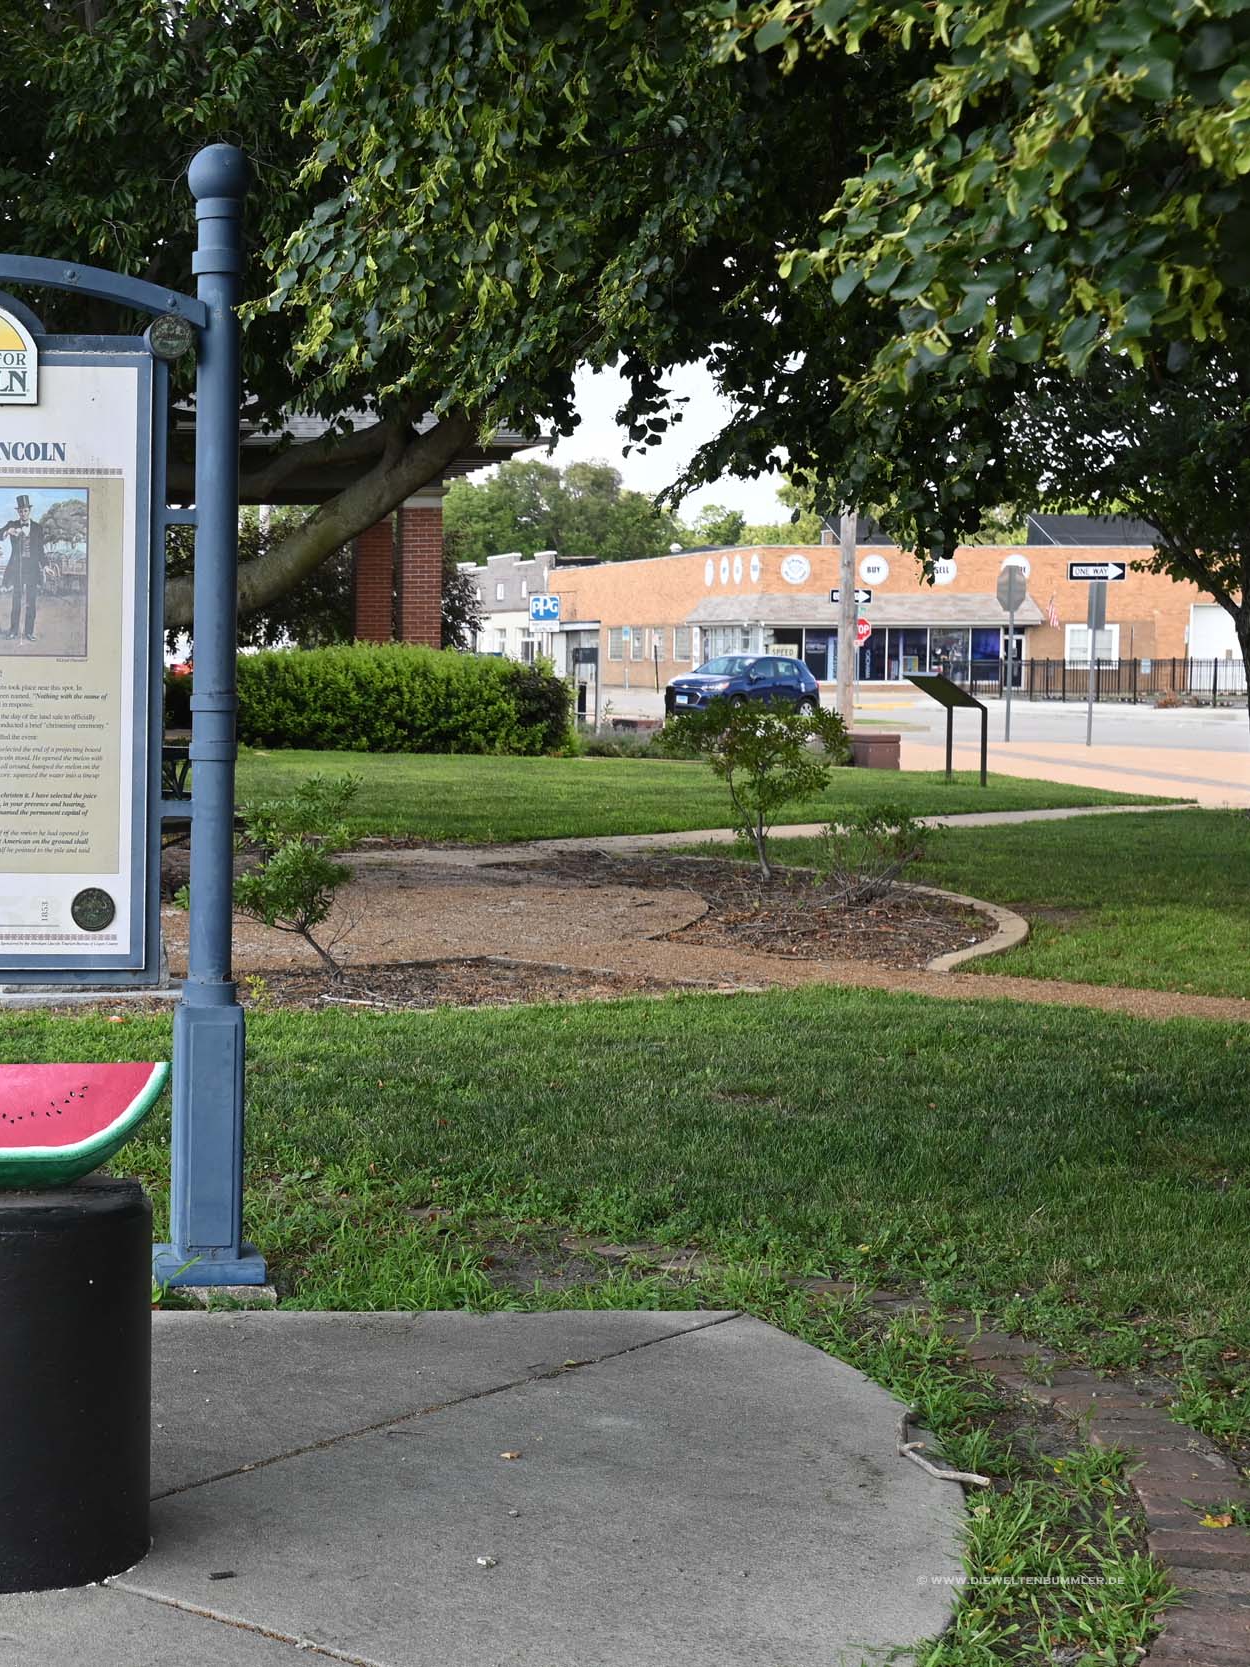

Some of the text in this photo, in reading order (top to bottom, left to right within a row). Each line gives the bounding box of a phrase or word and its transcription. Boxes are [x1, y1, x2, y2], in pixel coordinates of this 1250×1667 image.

[866, 566, 881, 574] BUY
[935, 566, 949, 574] SELL
[1074, 567, 1109, 576] ONE WAY
[532, 596, 558, 616] PPG
[772, 648, 794, 656] SPEED
